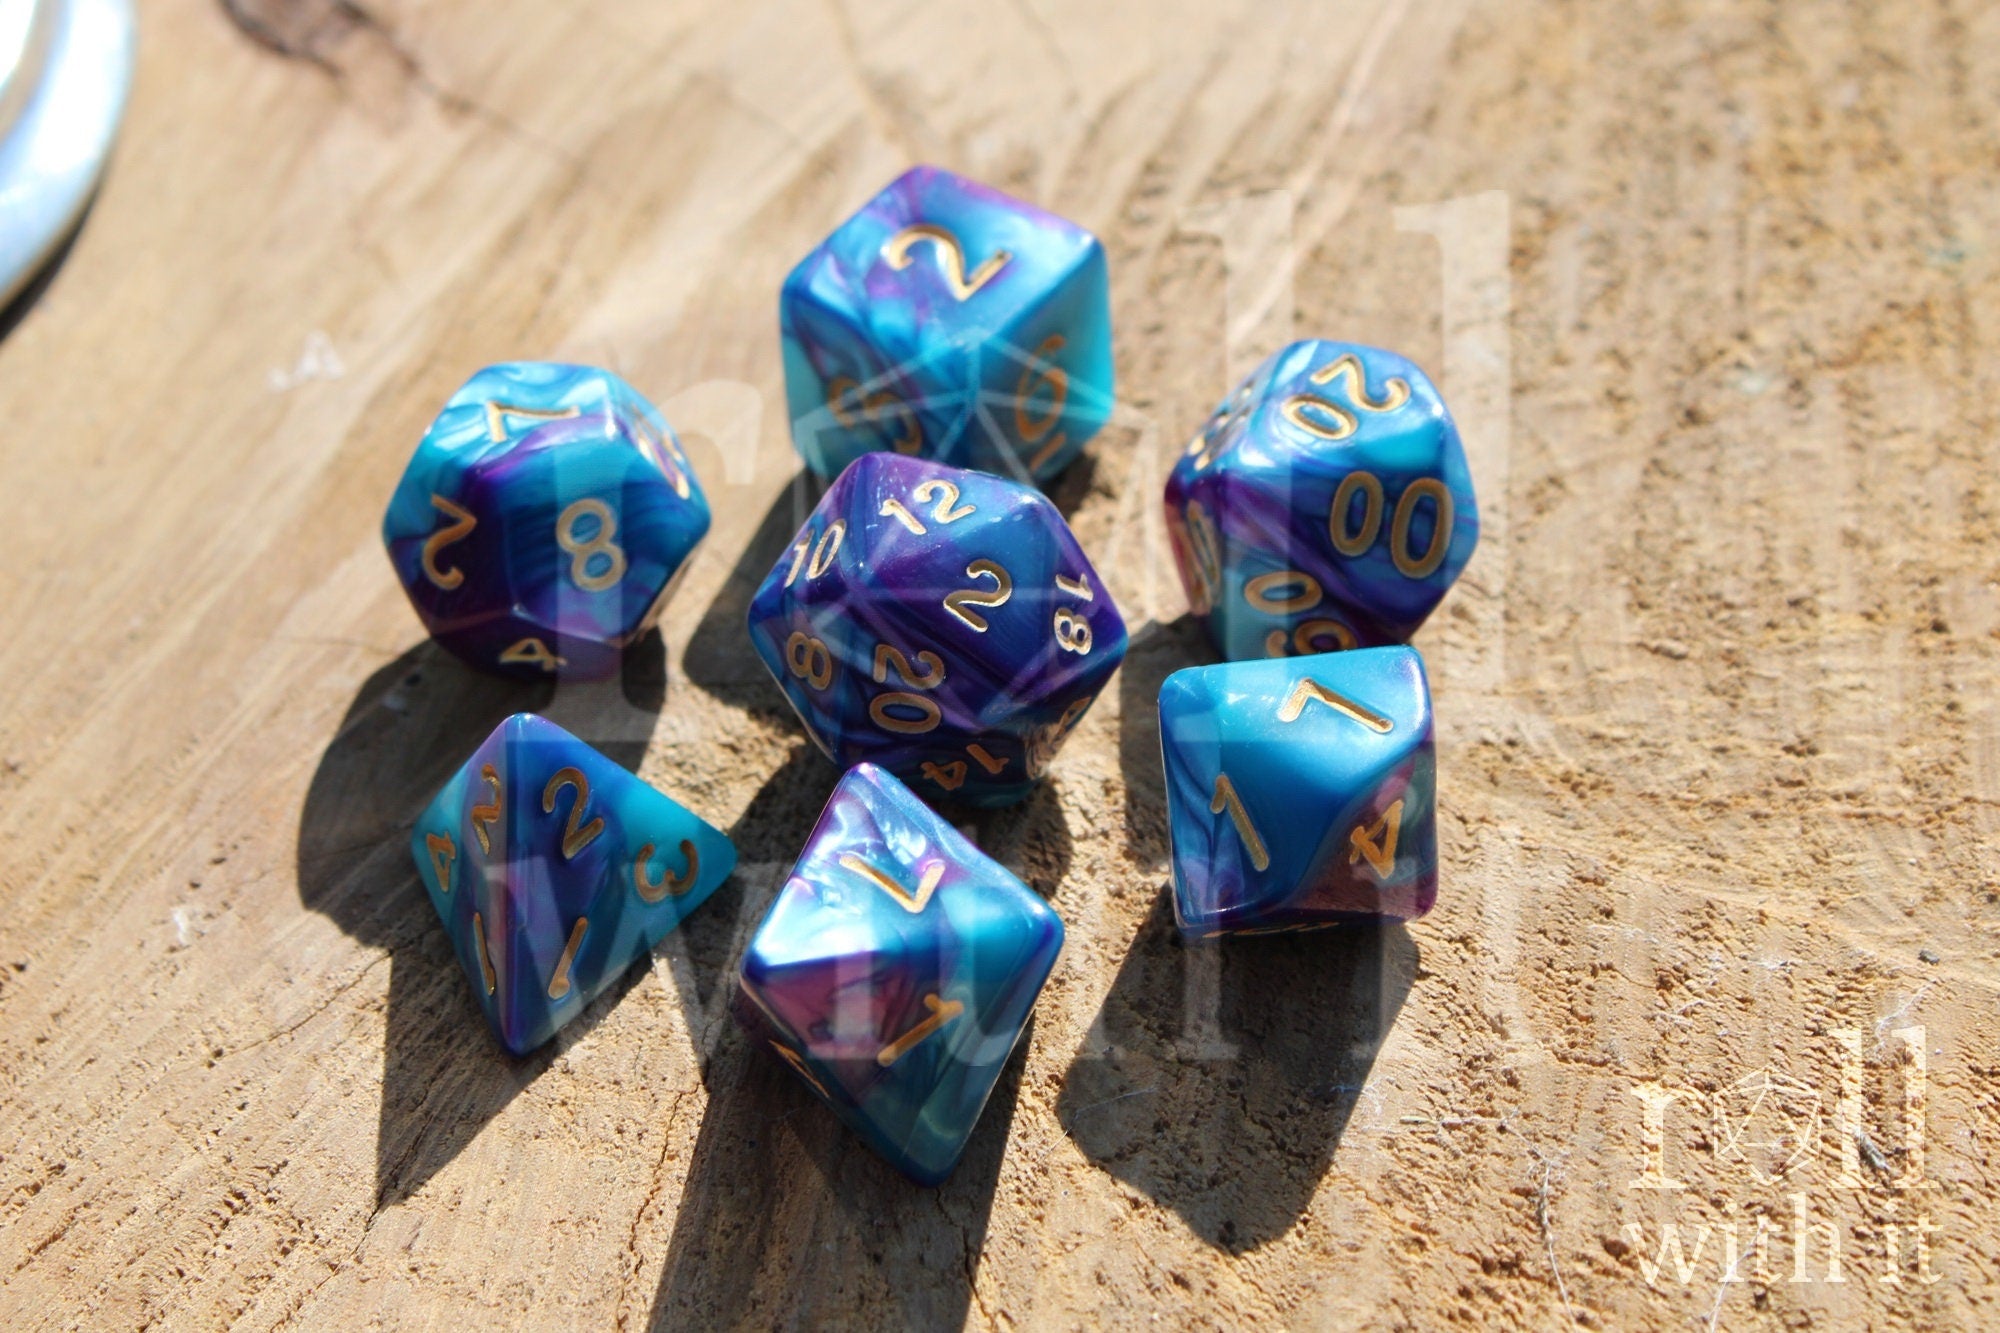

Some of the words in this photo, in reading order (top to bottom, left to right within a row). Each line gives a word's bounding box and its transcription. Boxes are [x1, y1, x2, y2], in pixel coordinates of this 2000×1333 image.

[881, 224, 1014, 301] 2
[1281, 354, 1411, 440] 20
[422, 494, 478, 591] 2
[556, 499, 627, 591] 8
[879, 480, 976, 534] 12
[1330, 471, 1453, 579] 00
[784, 519, 847, 588] 10
[943, 559, 1013, 632] 2
[1053, 573, 1094, 655] 18
[500, 638, 567, 671] 4
[786, 632, 832, 690] 8
[870, 645, 945, 734] 20
[1278, 677, 1393, 733] 7
[921, 744, 1009, 791] 14
[471, 763, 504, 856] 2
[543, 767, 605, 860] 2
[1210, 775, 1269, 871] 1
[1350, 799, 1404, 880] 4
[426, 831, 456, 892] 4
[633, 839, 699, 903] 3
[839, 859, 946, 914] 7
[548, 917, 589, 1000] 1
[877, 993, 964, 1067] 1
